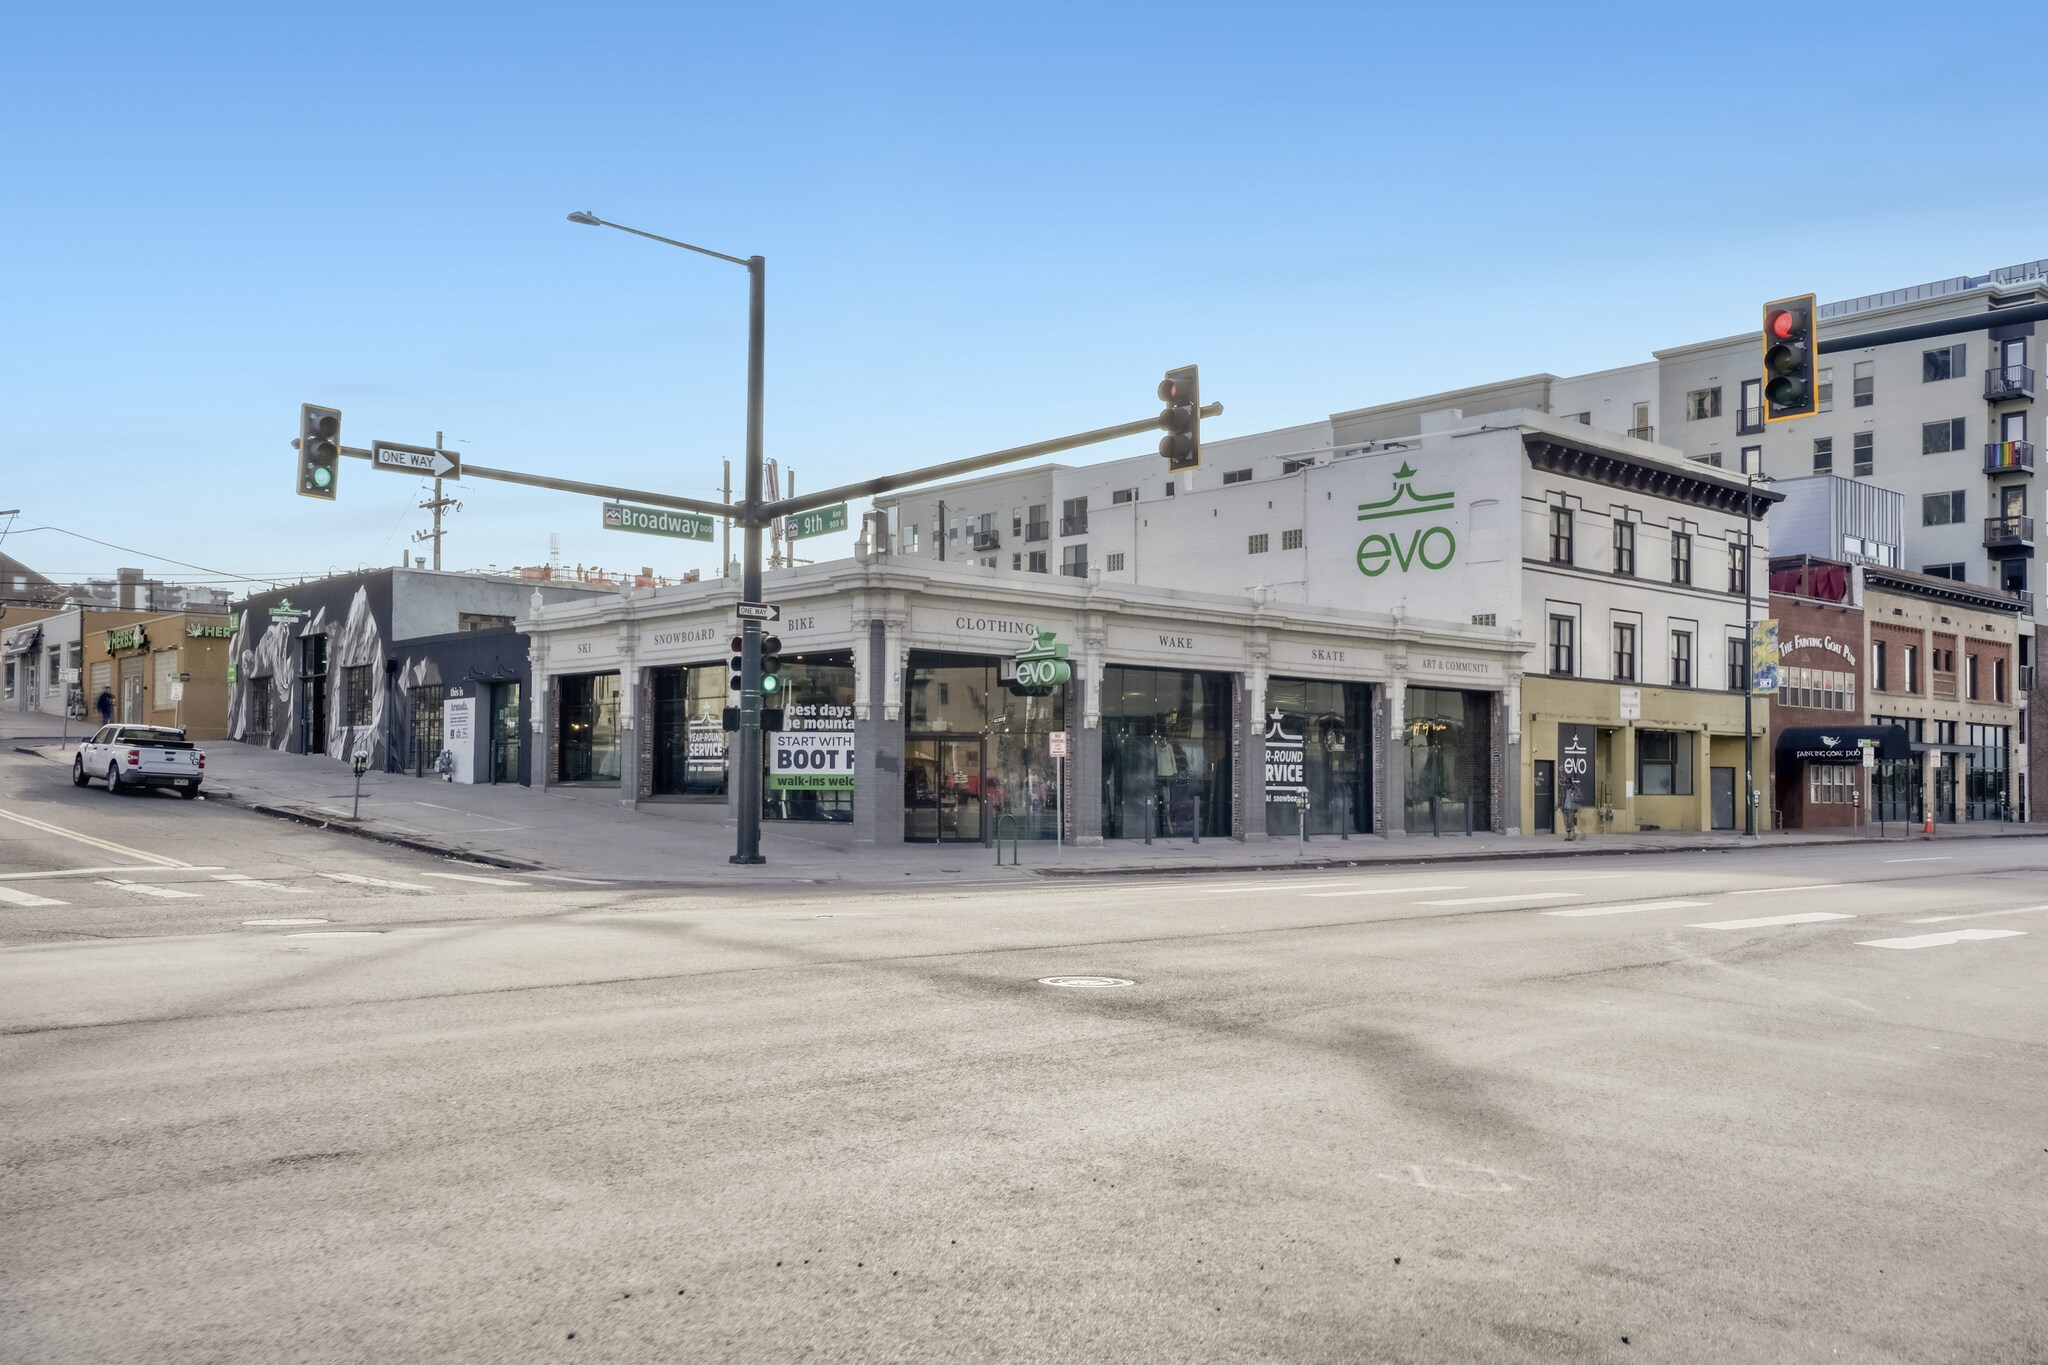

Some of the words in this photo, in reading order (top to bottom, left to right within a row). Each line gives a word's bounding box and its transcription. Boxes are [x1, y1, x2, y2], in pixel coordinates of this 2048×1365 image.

[382, 450, 406, 465] ONE
[410, 455, 434, 468] WAY
[832, 510, 841, 518] Ave
[622, 508, 699, 538] Broadway
[804, 514, 823, 535] 9th
[829, 520, 840, 529] 900
[1356, 526, 1456, 577] evo
[740, 607, 753, 615] ONE
[788, 617, 815, 632] BIKE
[956, 617, 1034, 636] CLOTHING
[654, 628, 715, 646] SNOWBOARD
[1159, 635, 1193, 649] WAKE
[577, 643, 591, 654] SKI
[1312, 649, 1345, 662] SKATE
[1016, 660, 1056, 686] evo
[1422, 659, 1436, 669] ART
[1438, 660, 1444, 670] &
[1445, 660, 1489, 674] COMMUNITY
[786, 704, 817, 716] best
[819, 703, 852, 717] days
[689, 732, 724, 742] YEAR-ROUND
[777, 736, 816, 746] START
[818, 736, 852, 746] WITH
[689, 743, 723, 757] SERVICE
[777, 749, 840, 769] BOOT
[1564, 758, 1587, 775] evo
[777, 776, 825, 787] walk-ins
